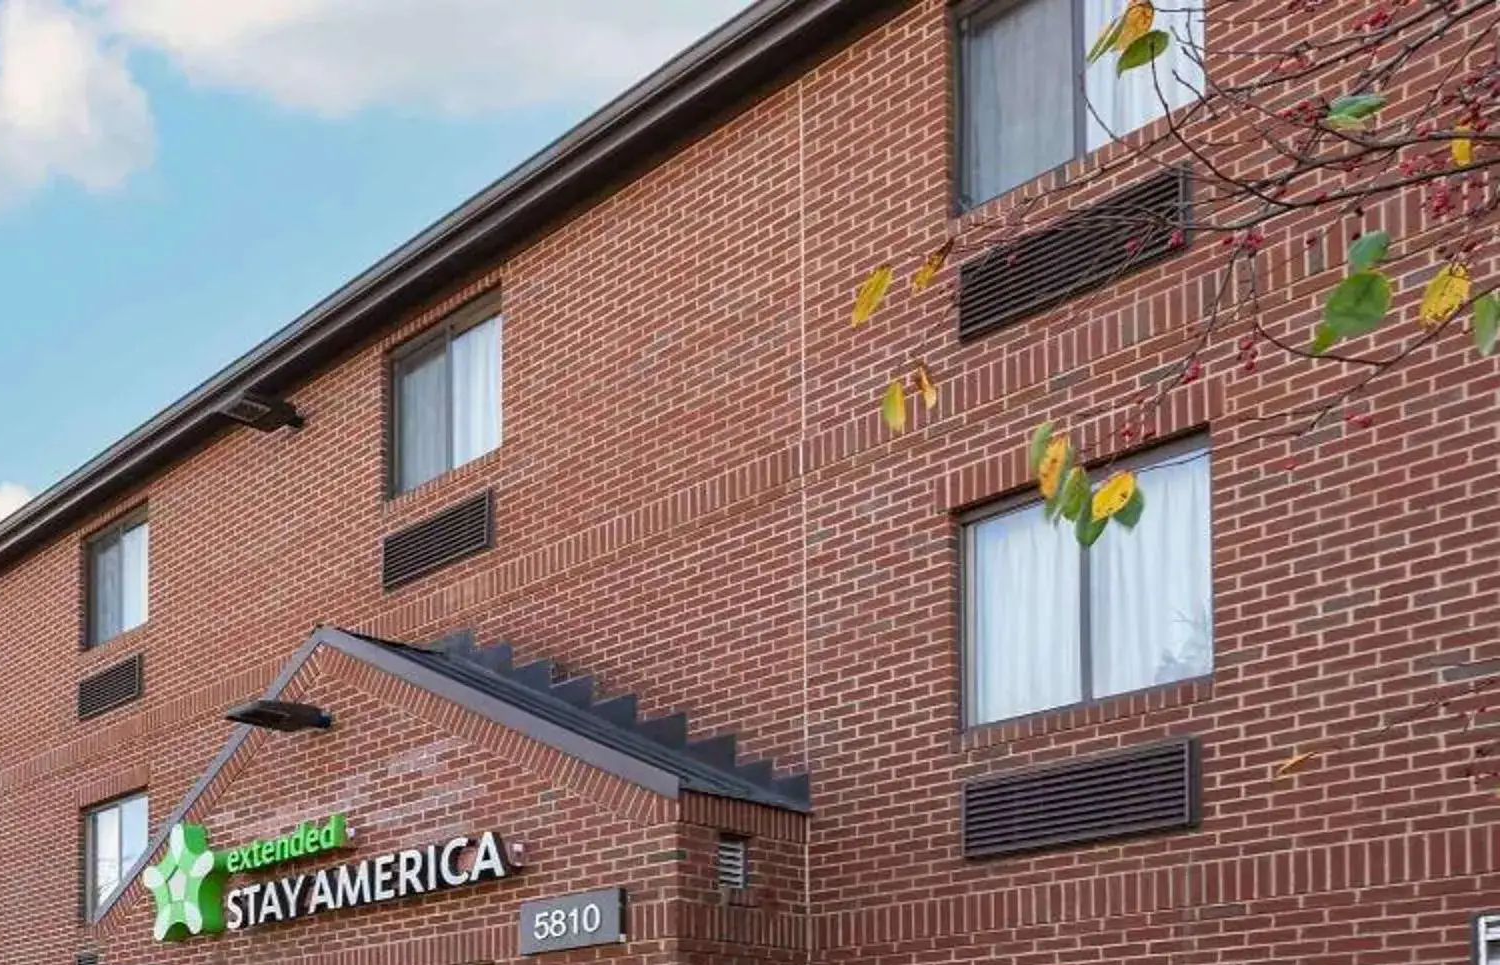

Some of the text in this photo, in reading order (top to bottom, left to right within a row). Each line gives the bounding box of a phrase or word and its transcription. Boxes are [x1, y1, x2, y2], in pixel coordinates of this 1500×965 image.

[226, 816, 336, 873] extended
[226, 831, 506, 930] STAY AMERICA
[533, 903, 602, 940] 5810
